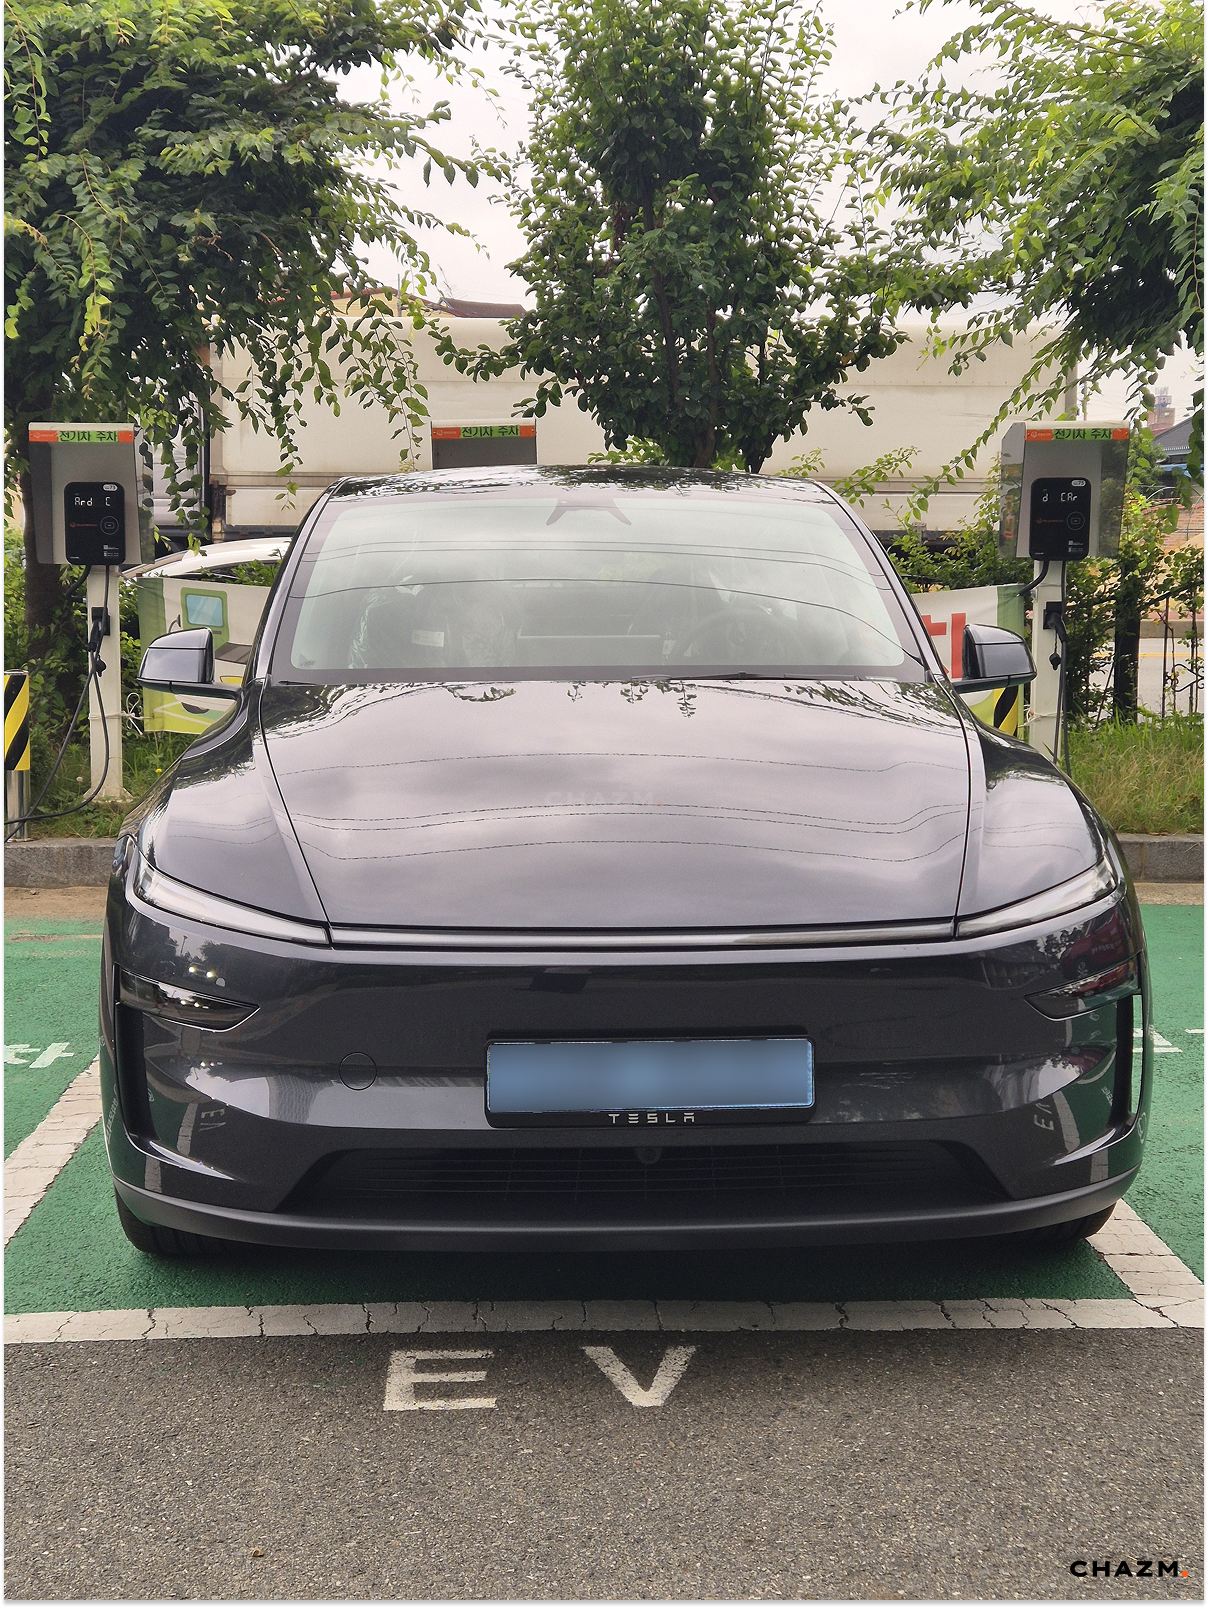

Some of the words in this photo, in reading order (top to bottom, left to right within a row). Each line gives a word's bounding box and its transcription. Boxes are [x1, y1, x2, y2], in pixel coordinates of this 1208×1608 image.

[59, 430, 91, 442] 전기차
[95, 430, 118, 442] 주차
[461, 426, 494, 438] 전기차
[497, 425, 520, 436] 주차
[1054, 428, 1087, 440] 전기차
[1090, 428, 1113, 440] 주차
[608, 1112, 695, 1124] TESLA
